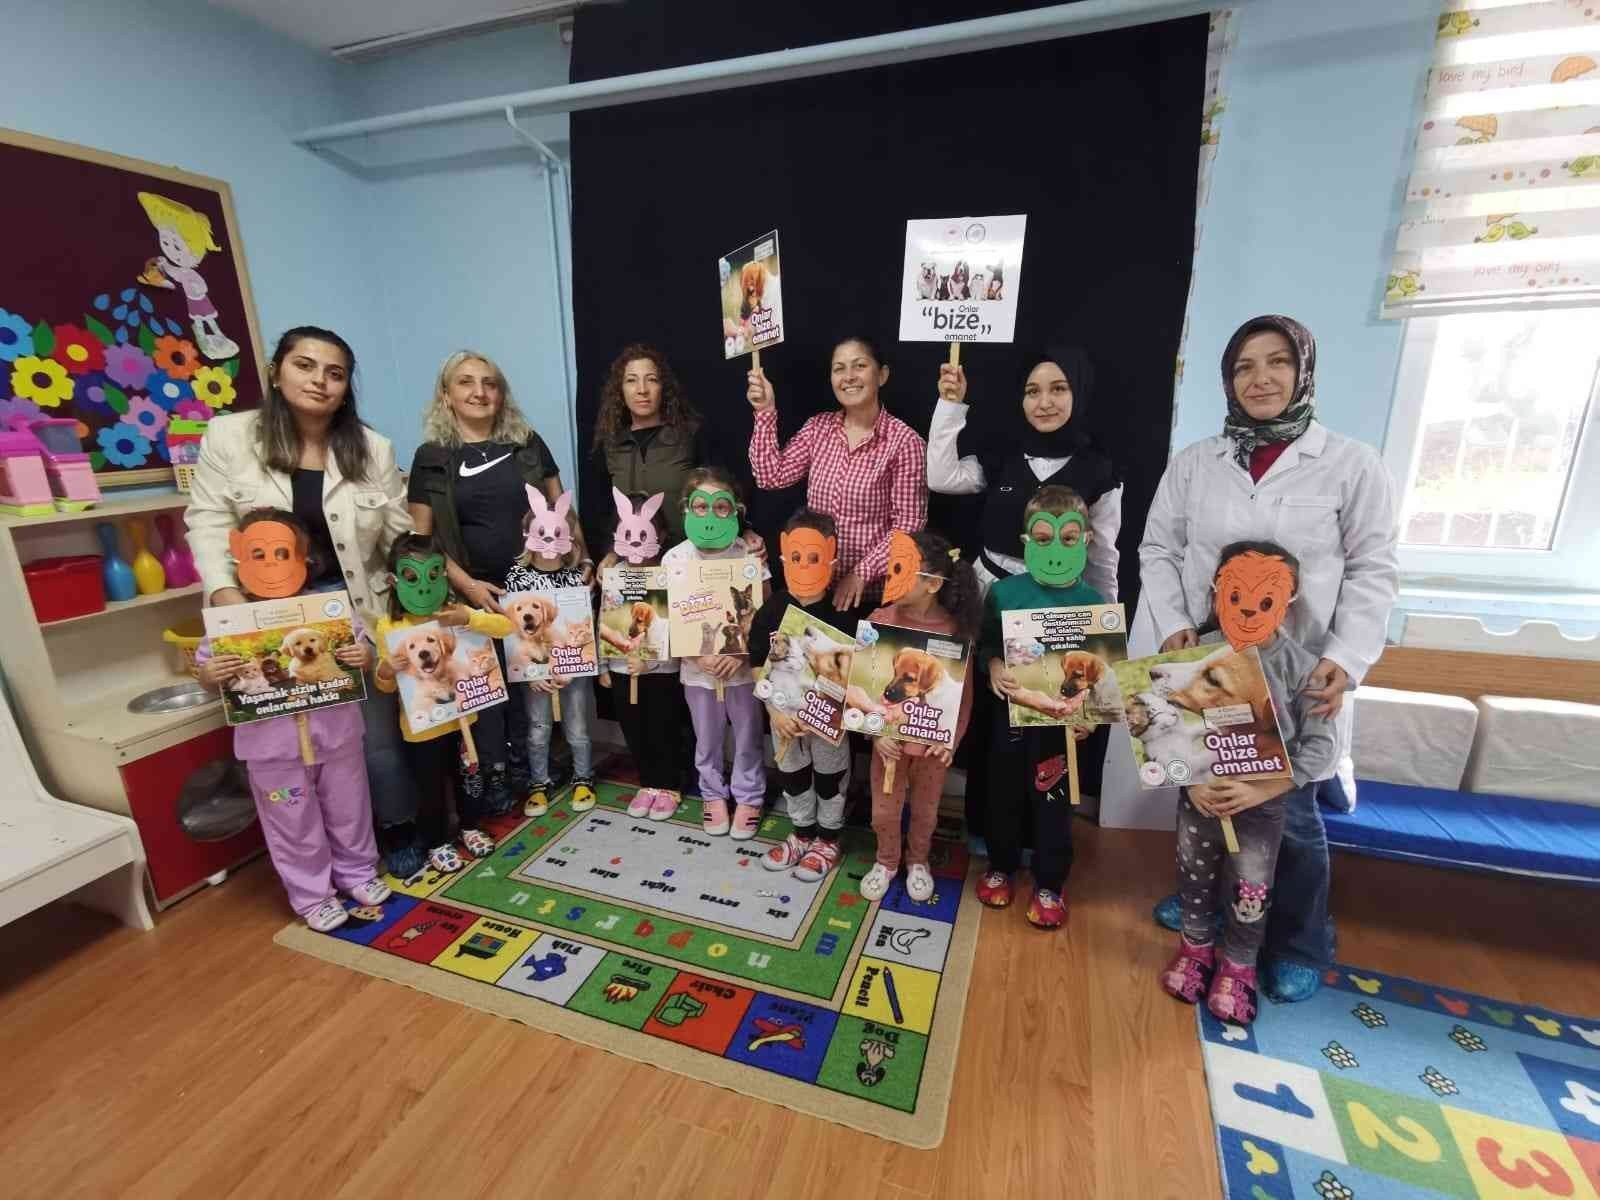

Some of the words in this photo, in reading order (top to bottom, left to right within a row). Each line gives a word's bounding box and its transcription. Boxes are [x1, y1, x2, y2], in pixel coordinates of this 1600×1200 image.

[958, 304, 979, 313] Onlar
[752, 327, 780, 344] emanet
[944, 332, 977, 341] emanet
[551, 646, 582, 657] Onlar
[553, 663, 595, 674] emanet
[558, 656, 581, 665] bize
[318, 677, 350, 691] kadar
[456, 673, 489, 692] Onlar
[465, 684, 490, 698] bize
[461, 688, 504, 710] emanet
[805, 690, 837, 716] Onlar
[807, 703, 832, 722] bize
[902, 702, 942, 720] Onlar
[798, 709, 839, 739] emanet
[908, 714, 938, 728] bize
[899, 725, 951, 743] emanet
[1205, 733, 1257, 750] Onlar
[1219, 747, 1259, 761] bize
[1212, 756, 1284, 775] emanet
[639, 879, 677, 893] eight
[699, 893, 741, 908] seven
[765, 907, 790, 919] six
[482, 920, 522, 938] House
[875, 925, 894, 947] Hen
[551, 940, 583, 955] Fish
[622, 959, 653, 976] Fire
[689, 980, 737, 999] Chair
[855, 965, 880, 1007] Pencil
[862, 1022, 900, 1043] Dog
[1232, 1081, 1316, 1119] 1
[1345, 1100, 1442, 1163] 2
[1475, 1136, 1575, 1197] 3
